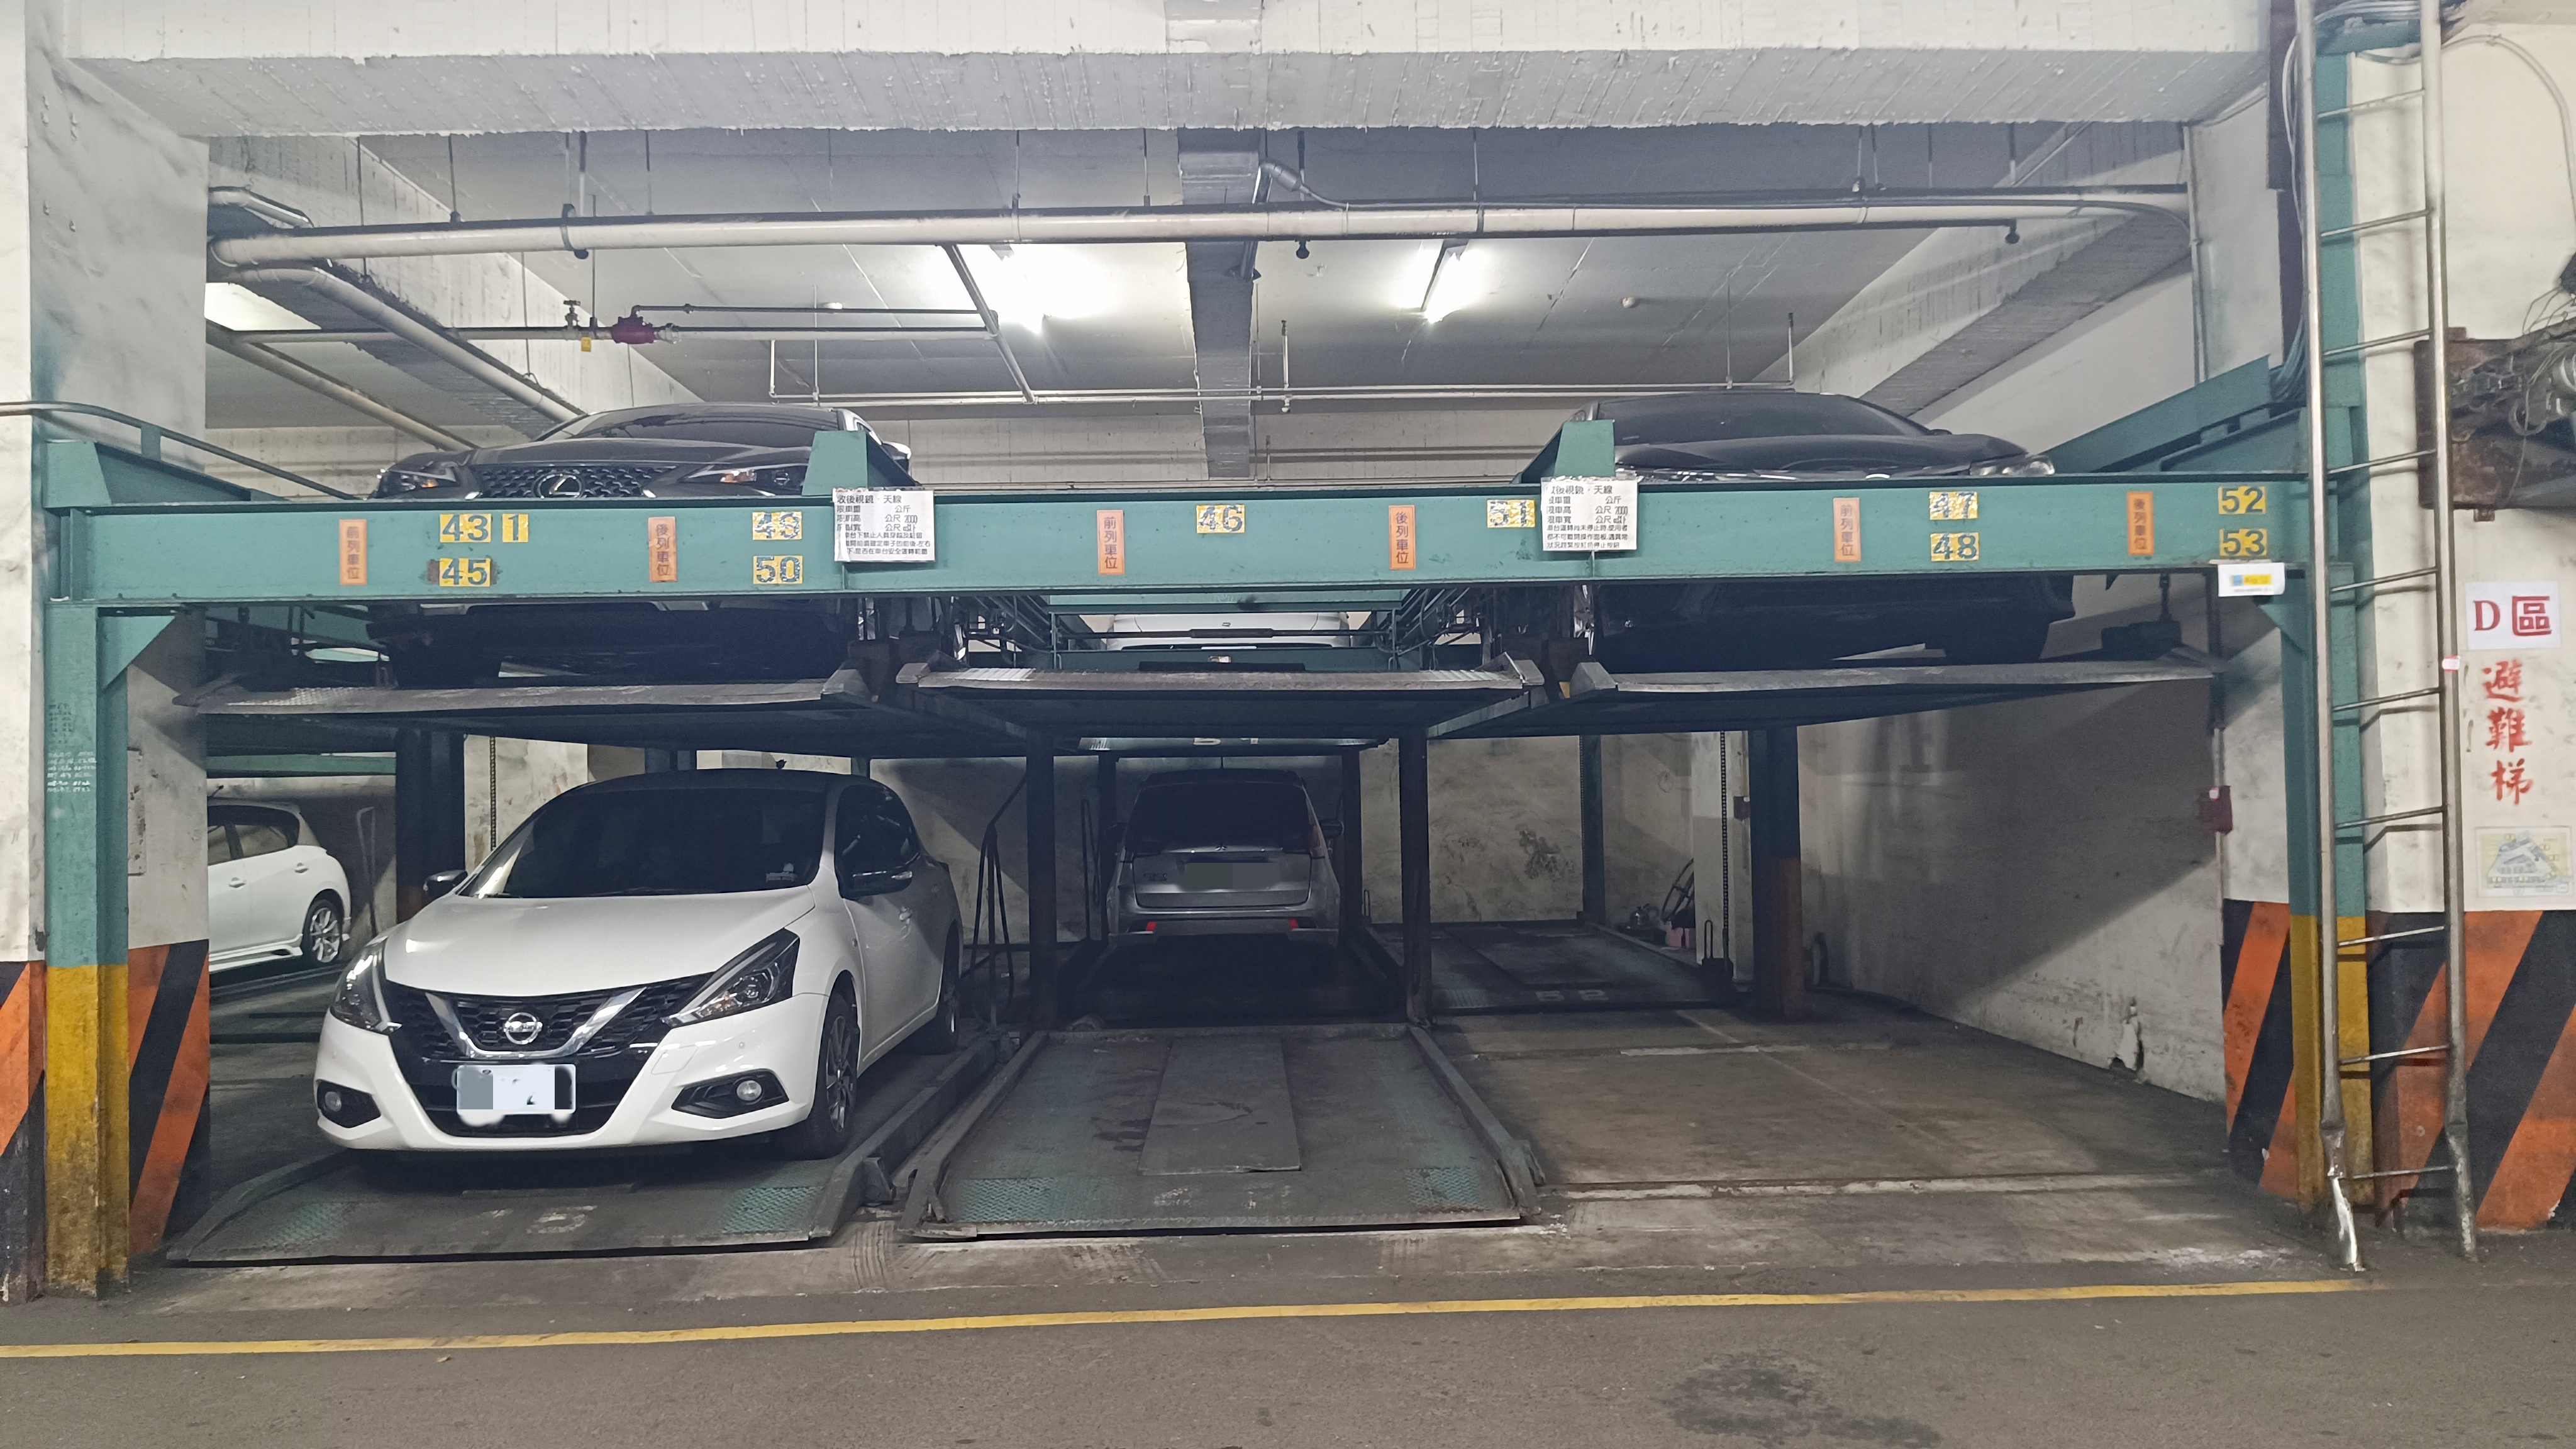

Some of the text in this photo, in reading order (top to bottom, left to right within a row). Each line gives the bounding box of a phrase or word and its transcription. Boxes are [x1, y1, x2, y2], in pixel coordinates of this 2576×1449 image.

[894, 505, 911, 513] 公斤
[1595, 506, 1611, 514] 公尺
[1605, 496, 1622, 504] 公斤
[1930, 492, 1975, 519] 47
[2222, 487, 2263, 513] 52
[885, 514, 901, 523] 公尺
[1198, 506, 1243, 531] 46
[1490, 501, 1527, 526] 51
[1595, 516, 1611, 524] 公尺
[442, 514, 519, 541] 43 1
[885, 523, 901, 531] 公尺
[1396, 512, 1409, 564] 後列車位
[1840, 505, 1854, 556] 前列車位
[347, 526, 360, 580] 前列車位
[656, 523, 670, 577] 後列車位
[1104, 516, 1118, 569] 前列車位
[1933, 535, 1977, 560] 48
[2223, 530, 2265, 555] 53
[441, 558, 487, 585] 45
[757, 557, 801, 583] 50
[2473, 595, 2551, 636] D 區
[2481, 659, 2533, 805] 避難梯
